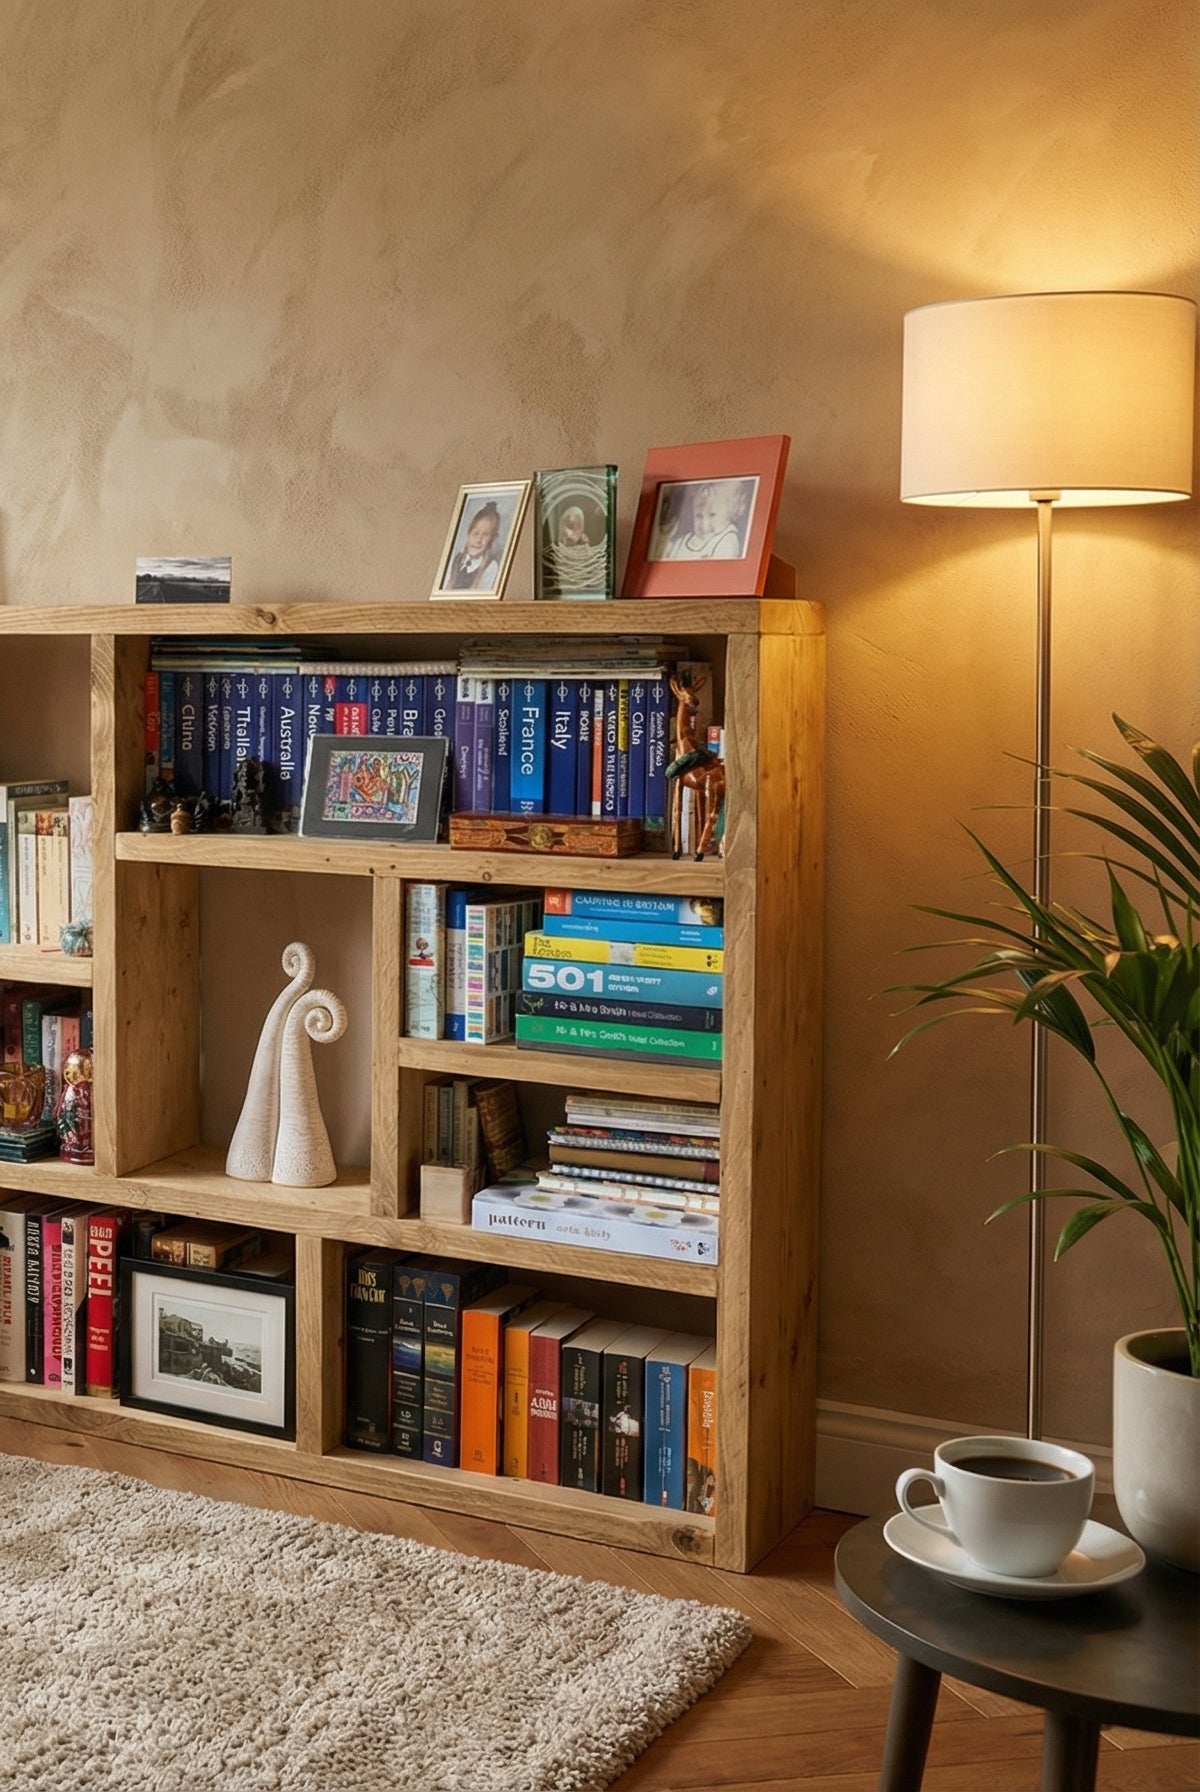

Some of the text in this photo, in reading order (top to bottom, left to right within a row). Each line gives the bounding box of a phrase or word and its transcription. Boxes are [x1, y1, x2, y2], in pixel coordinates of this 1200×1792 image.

[520, 706, 540, 776] France
[550, 710, 573, 750] Italy
[527, 963, 604, 993] 501
[87, 1238, 113, 1299] PEEL
